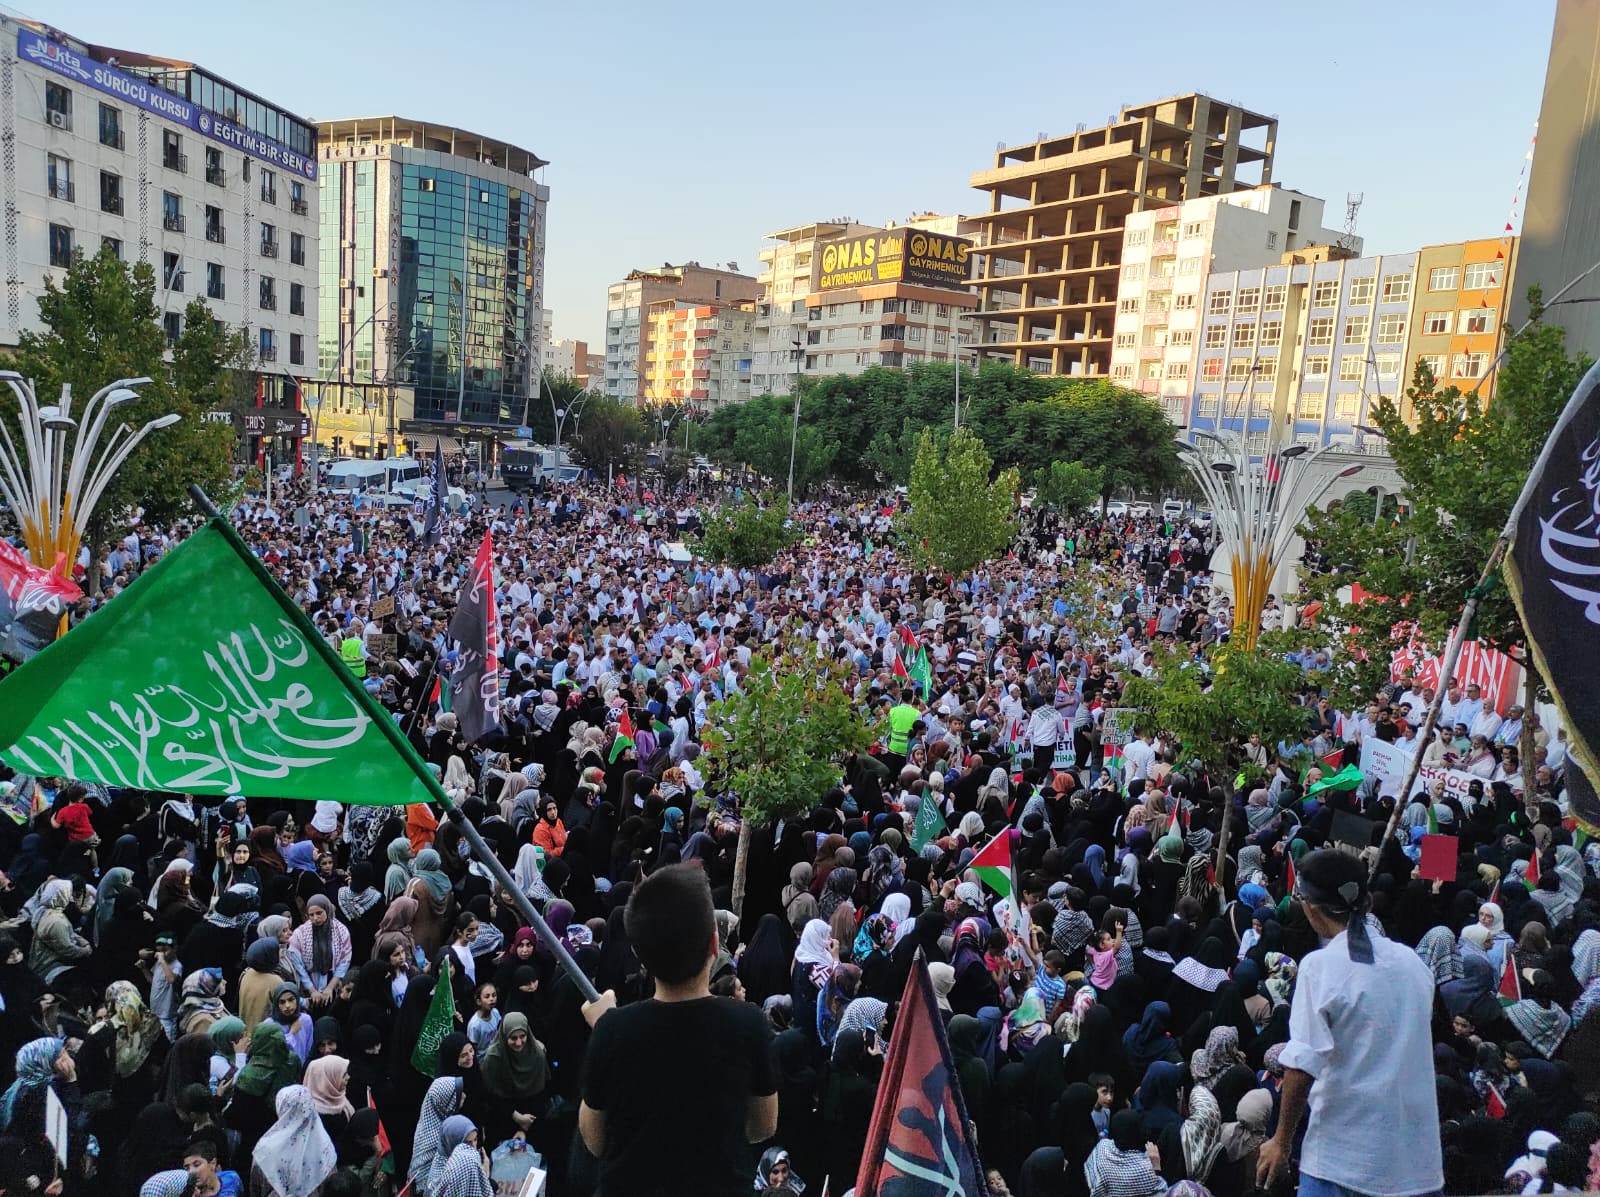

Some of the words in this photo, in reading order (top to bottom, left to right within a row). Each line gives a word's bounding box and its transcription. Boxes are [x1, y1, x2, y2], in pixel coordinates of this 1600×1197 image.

[94, 69, 147, 102] SÜRÜCÜ
[150, 93, 190, 121] KURSU
[213, 120, 304, 172] EĞİTİM-BİR-SEN
